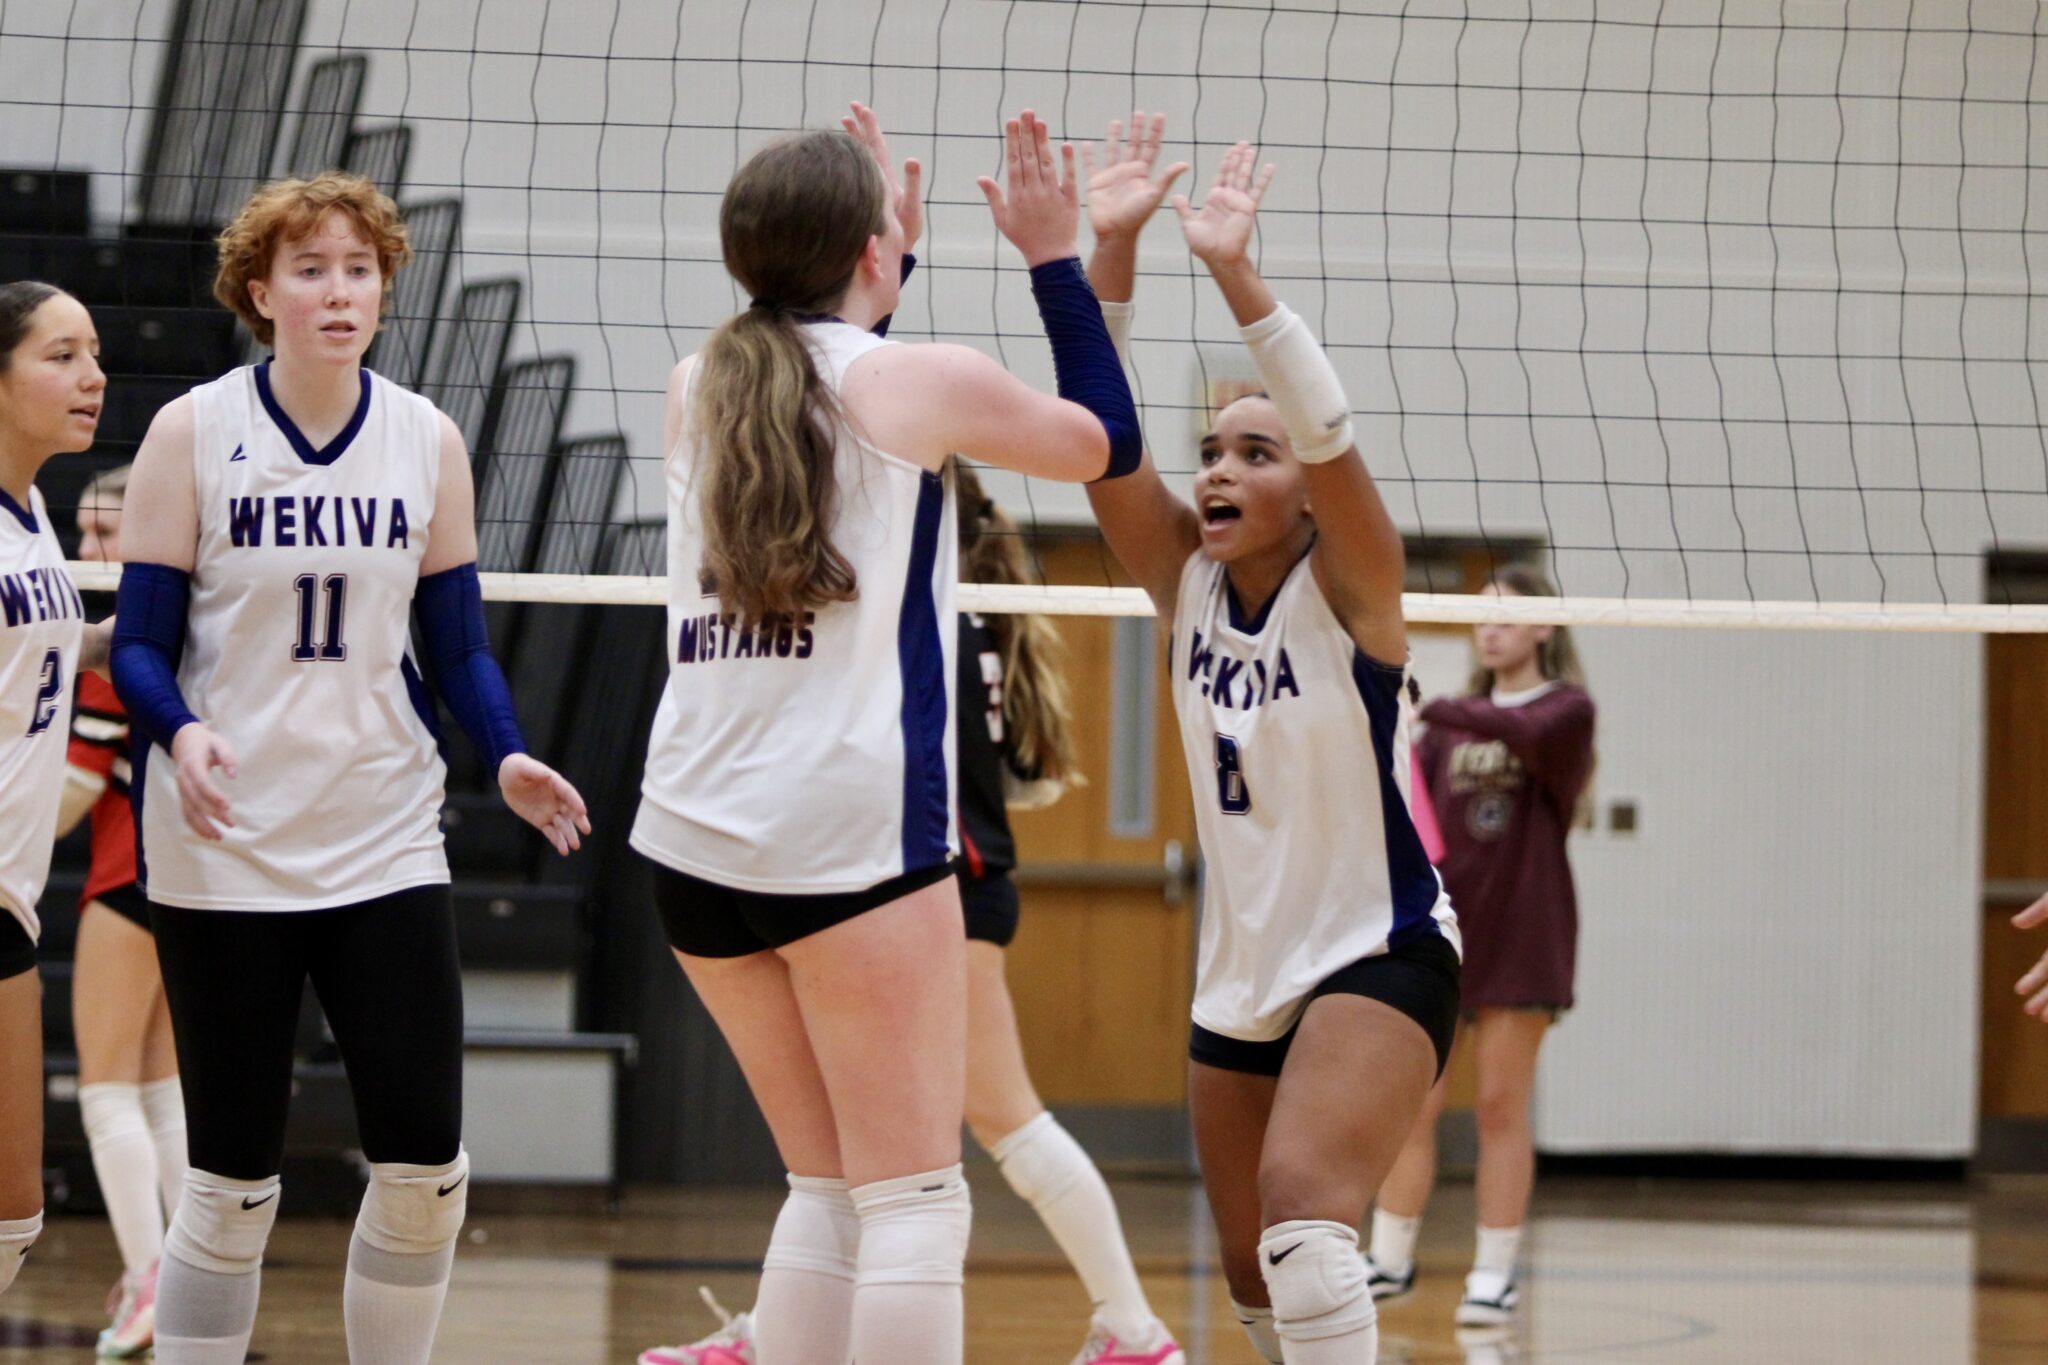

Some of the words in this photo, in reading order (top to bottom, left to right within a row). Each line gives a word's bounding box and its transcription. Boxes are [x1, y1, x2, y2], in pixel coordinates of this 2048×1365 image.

[230, 496, 408, 549] WEKIVA
[292, 573, 348, 661] 11
[677, 611, 816, 664] MUSTANGS
[25, 646, 64, 738] 2
[1212, 731, 1253, 815] 8
